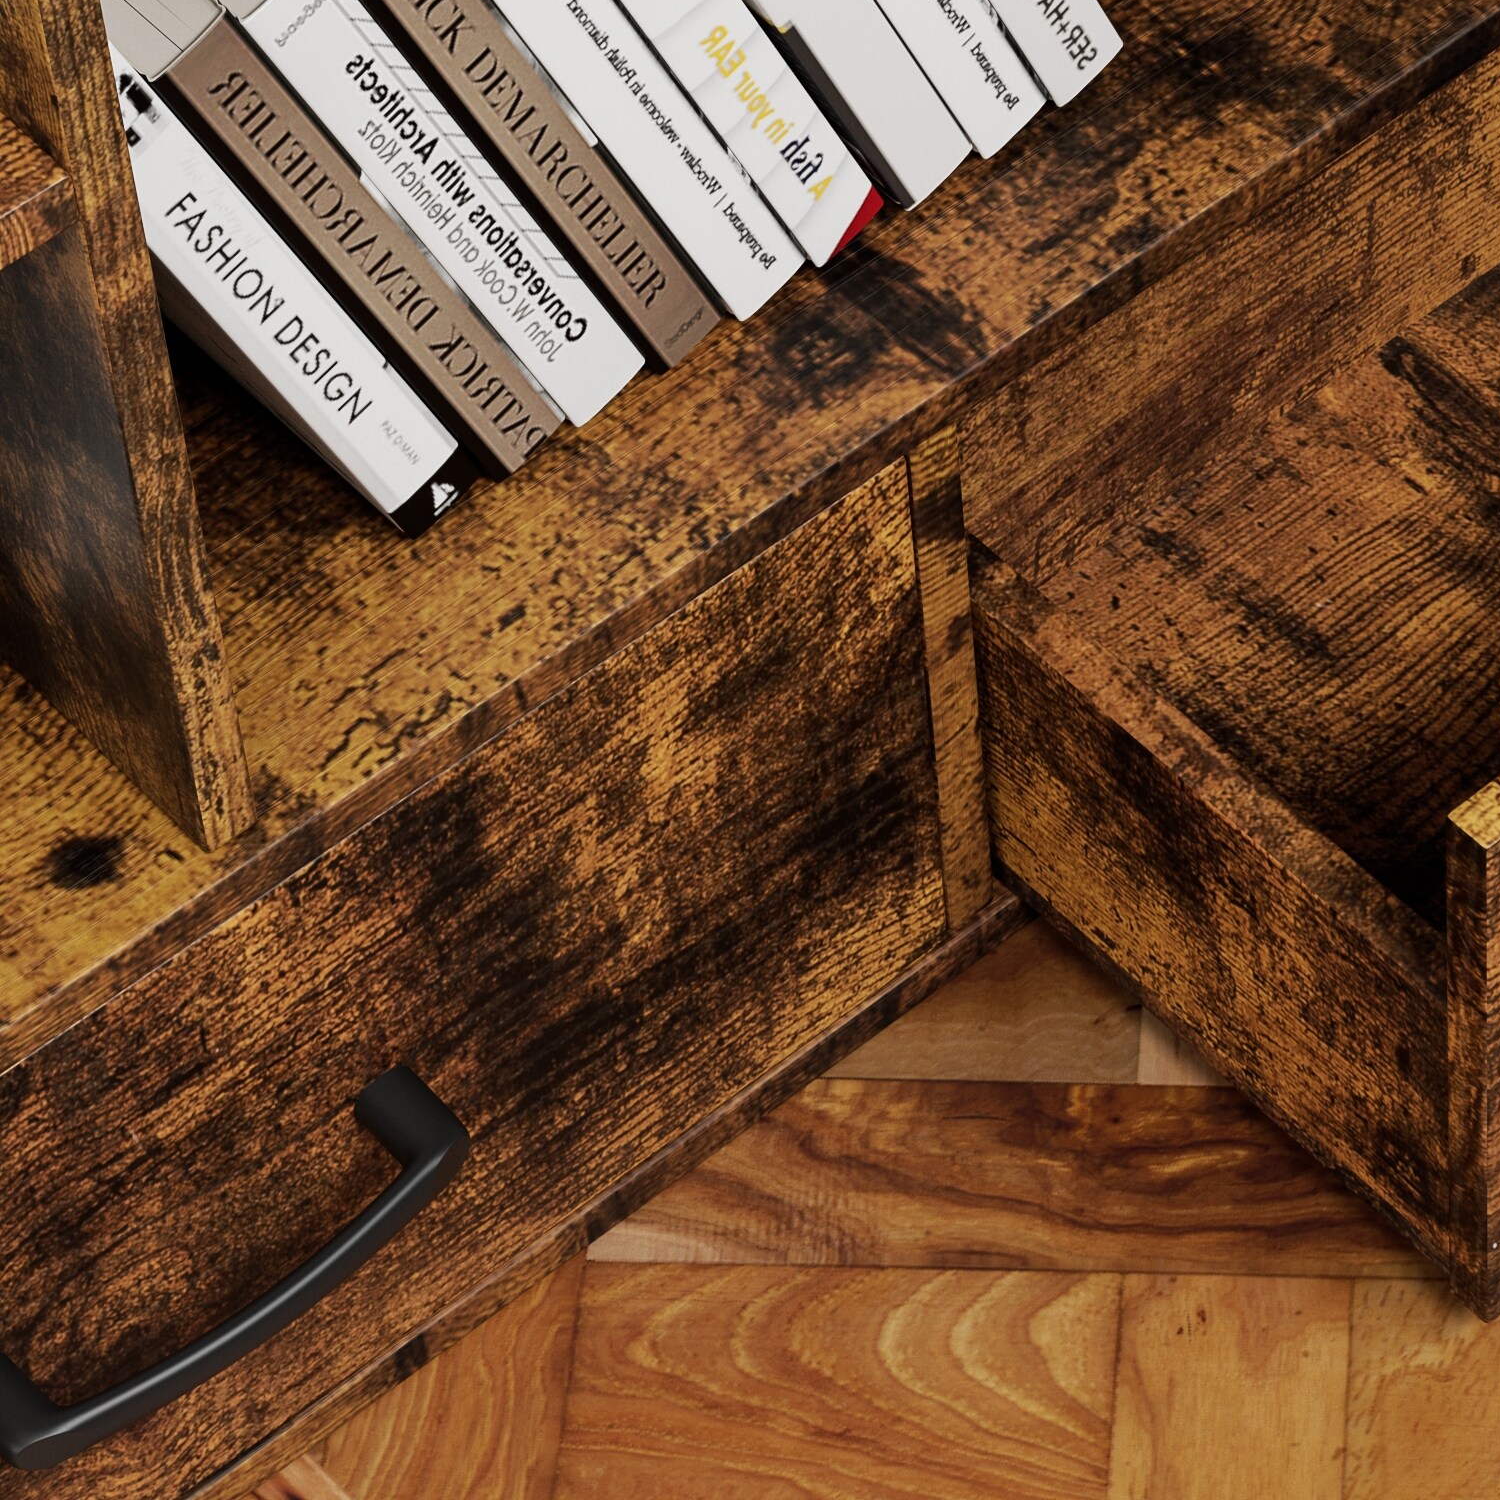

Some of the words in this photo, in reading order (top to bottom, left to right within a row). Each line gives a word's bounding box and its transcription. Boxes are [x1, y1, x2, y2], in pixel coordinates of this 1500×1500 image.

[463, 44, 670, 311] DEMARCHELIER
[163, 192, 286, 327] FASHION
[274, 314, 375, 428] DESIGN
